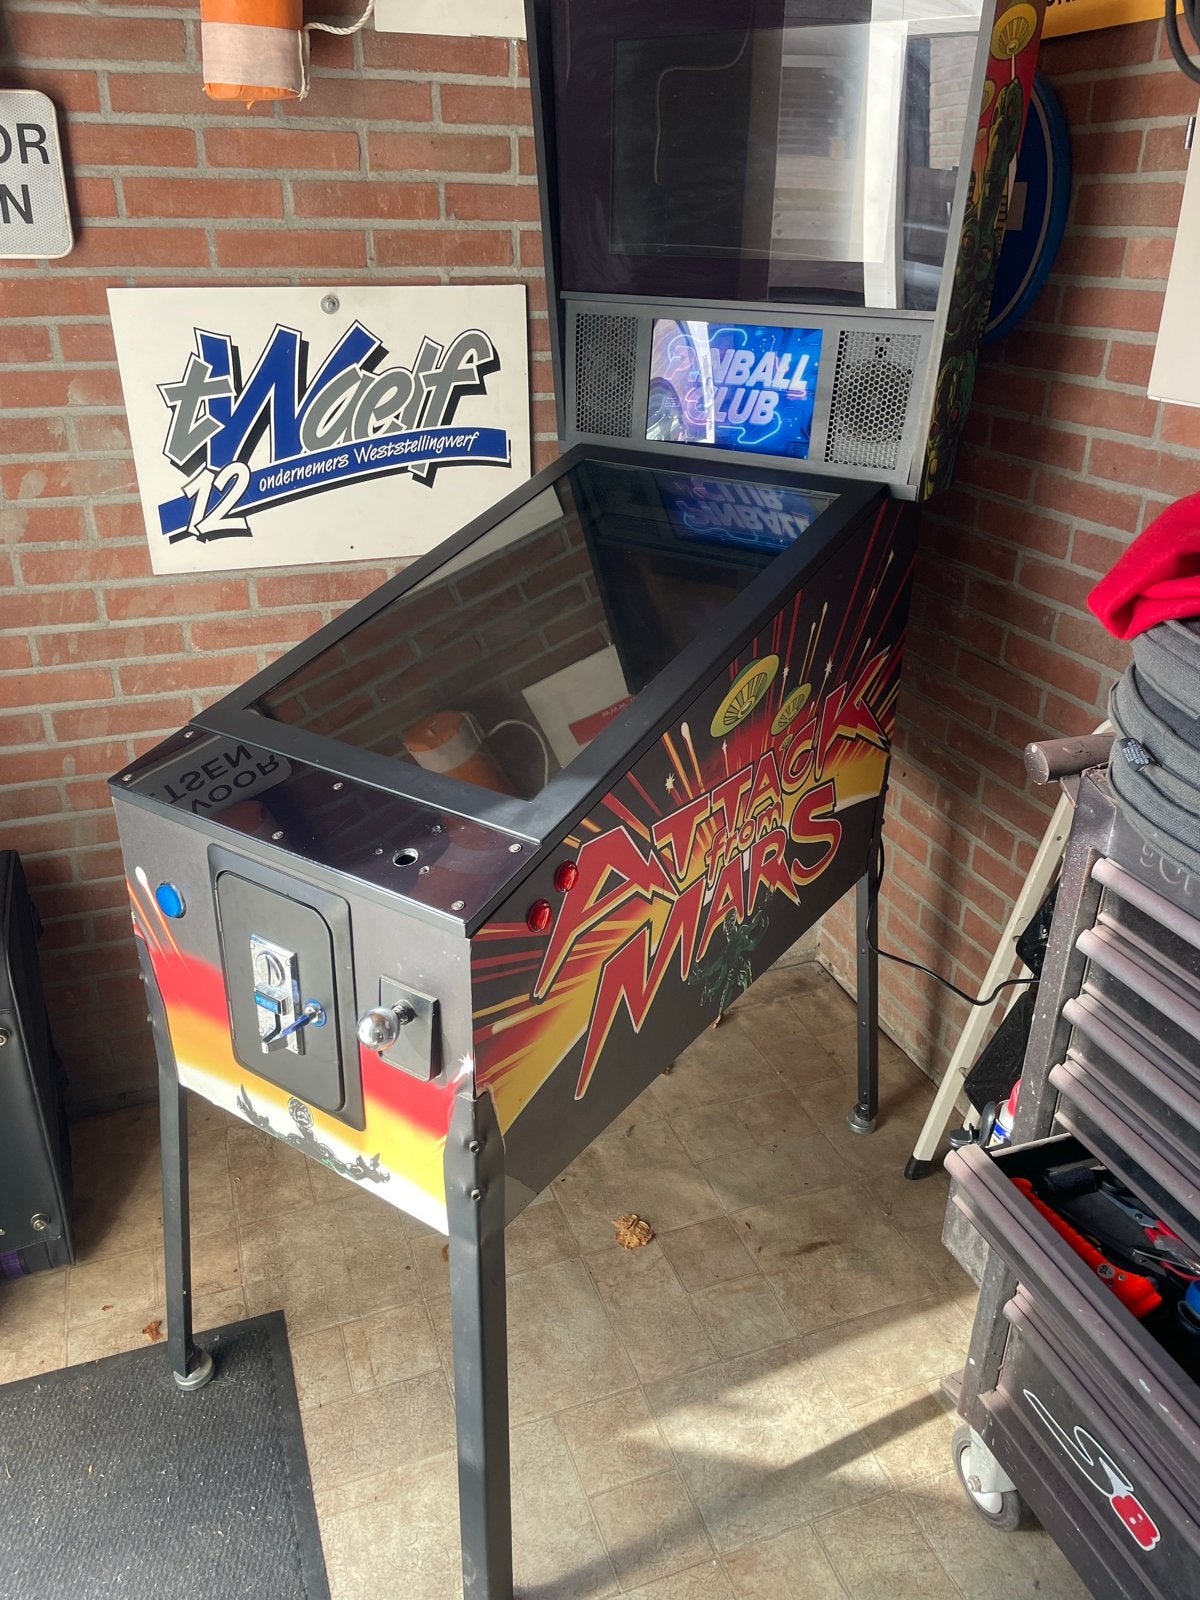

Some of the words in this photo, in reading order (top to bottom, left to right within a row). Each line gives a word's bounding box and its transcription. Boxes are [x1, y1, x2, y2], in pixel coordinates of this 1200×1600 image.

[685, 386, 779, 426] CLUB
[181, 461, 251, 536] 12
[258, 453, 350, 493] ondernemers
[353, 431, 480, 464] Weststellingwerf
[533, 645, 892, 999] ATTACK
[704, 800, 782, 888] from
[573, 780, 843, 1100] MARS
